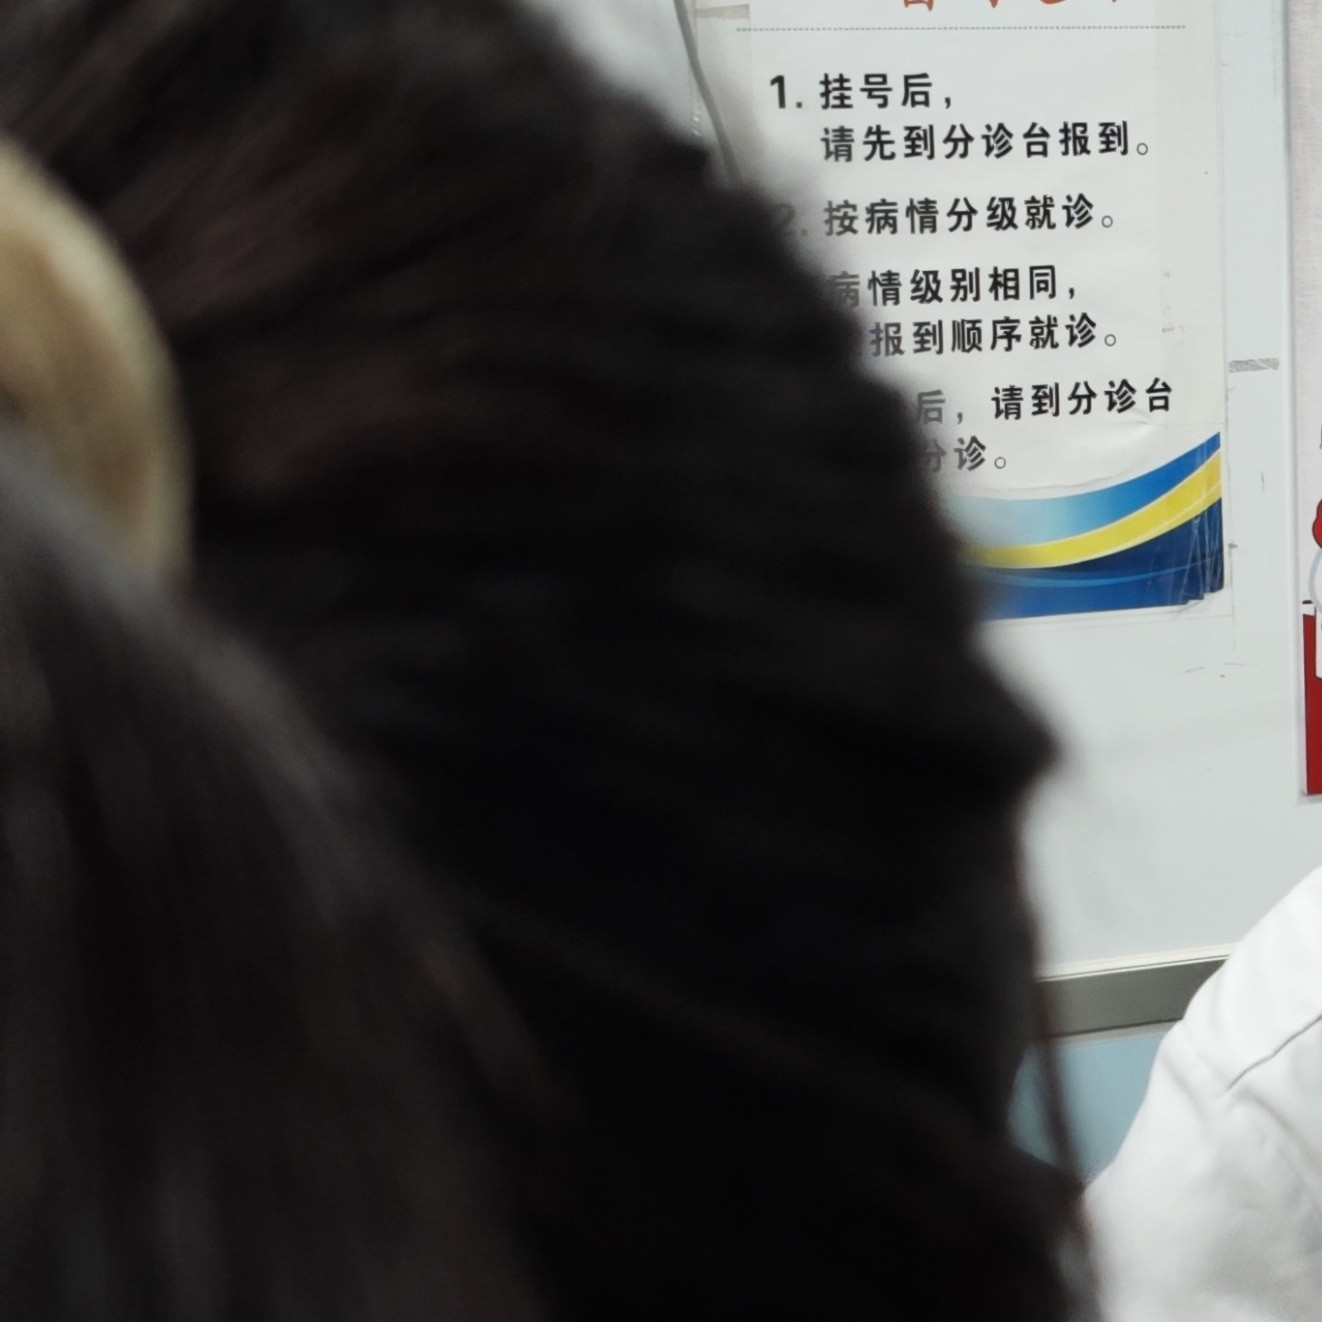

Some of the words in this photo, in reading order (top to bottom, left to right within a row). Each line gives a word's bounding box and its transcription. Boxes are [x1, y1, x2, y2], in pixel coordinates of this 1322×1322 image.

[769, 74, 803, 109] 1.
[819, 72, 952, 111] 挂号后，
[821, 120, 1149, 163] 请先到分诊台报到。
[823, 193, 1113, 237] 按病情分级就诊。
